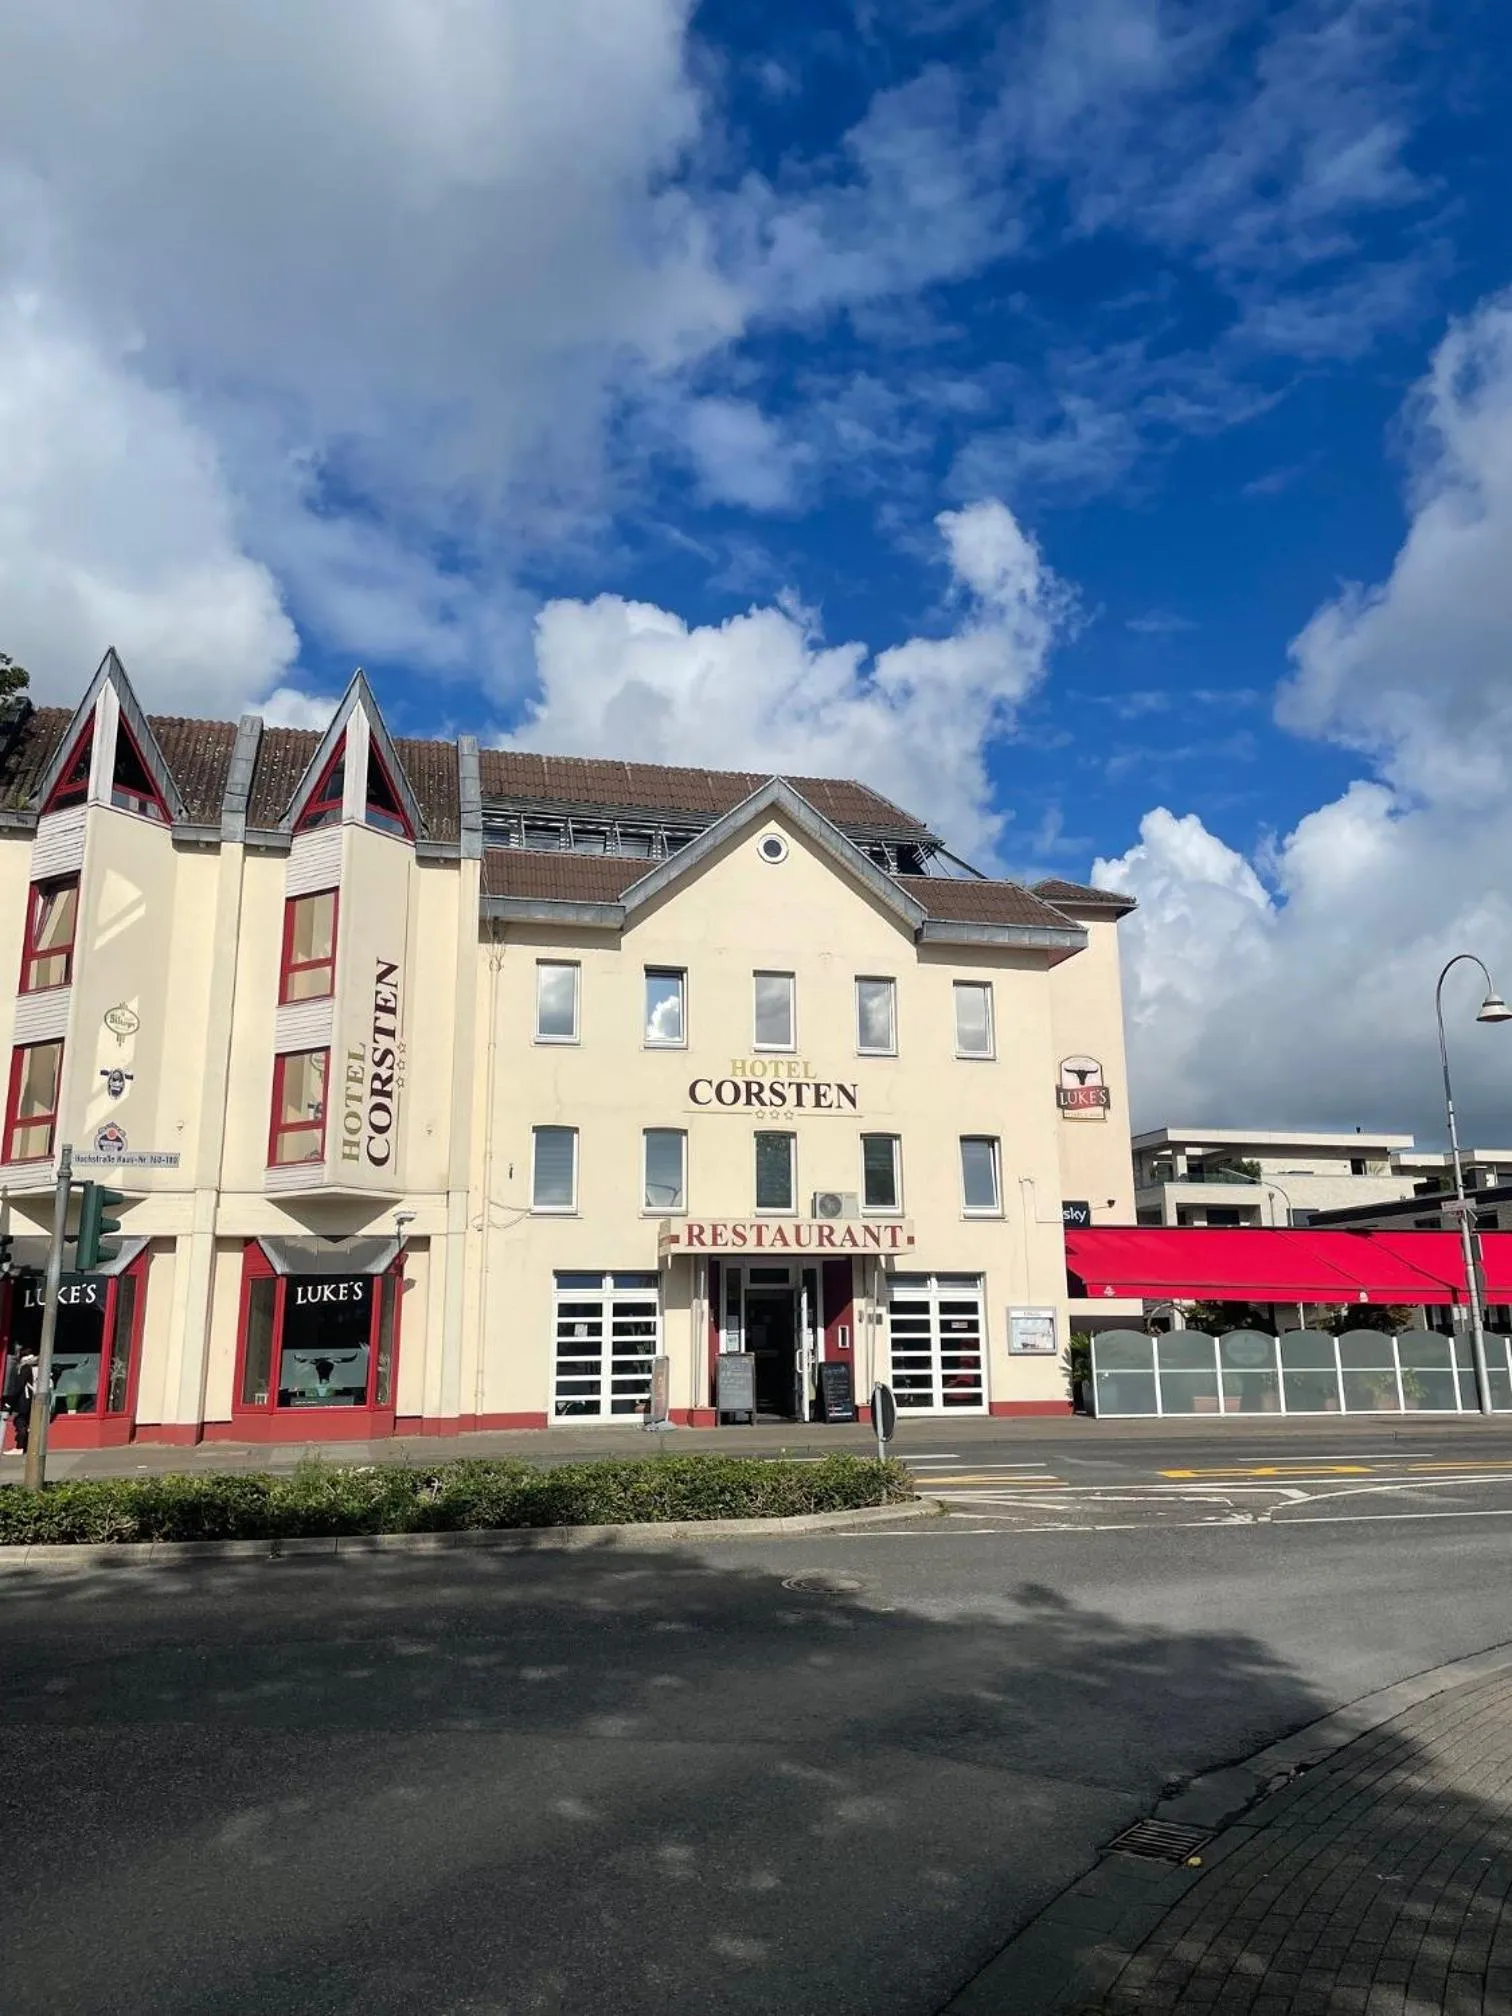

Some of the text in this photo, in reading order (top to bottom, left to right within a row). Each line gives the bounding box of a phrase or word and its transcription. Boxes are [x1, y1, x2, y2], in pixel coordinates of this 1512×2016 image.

[366, 956, 400, 1168] CORSTEN
[731, 1058, 818, 1080] HOTEL
[341, 1042, 366, 1163] HOTEL
[688, 1078, 859, 1110] CORSTEN
[1063, 1207, 1087, 1224] sky
[685, 1223, 903, 1248] RESTAURANT
